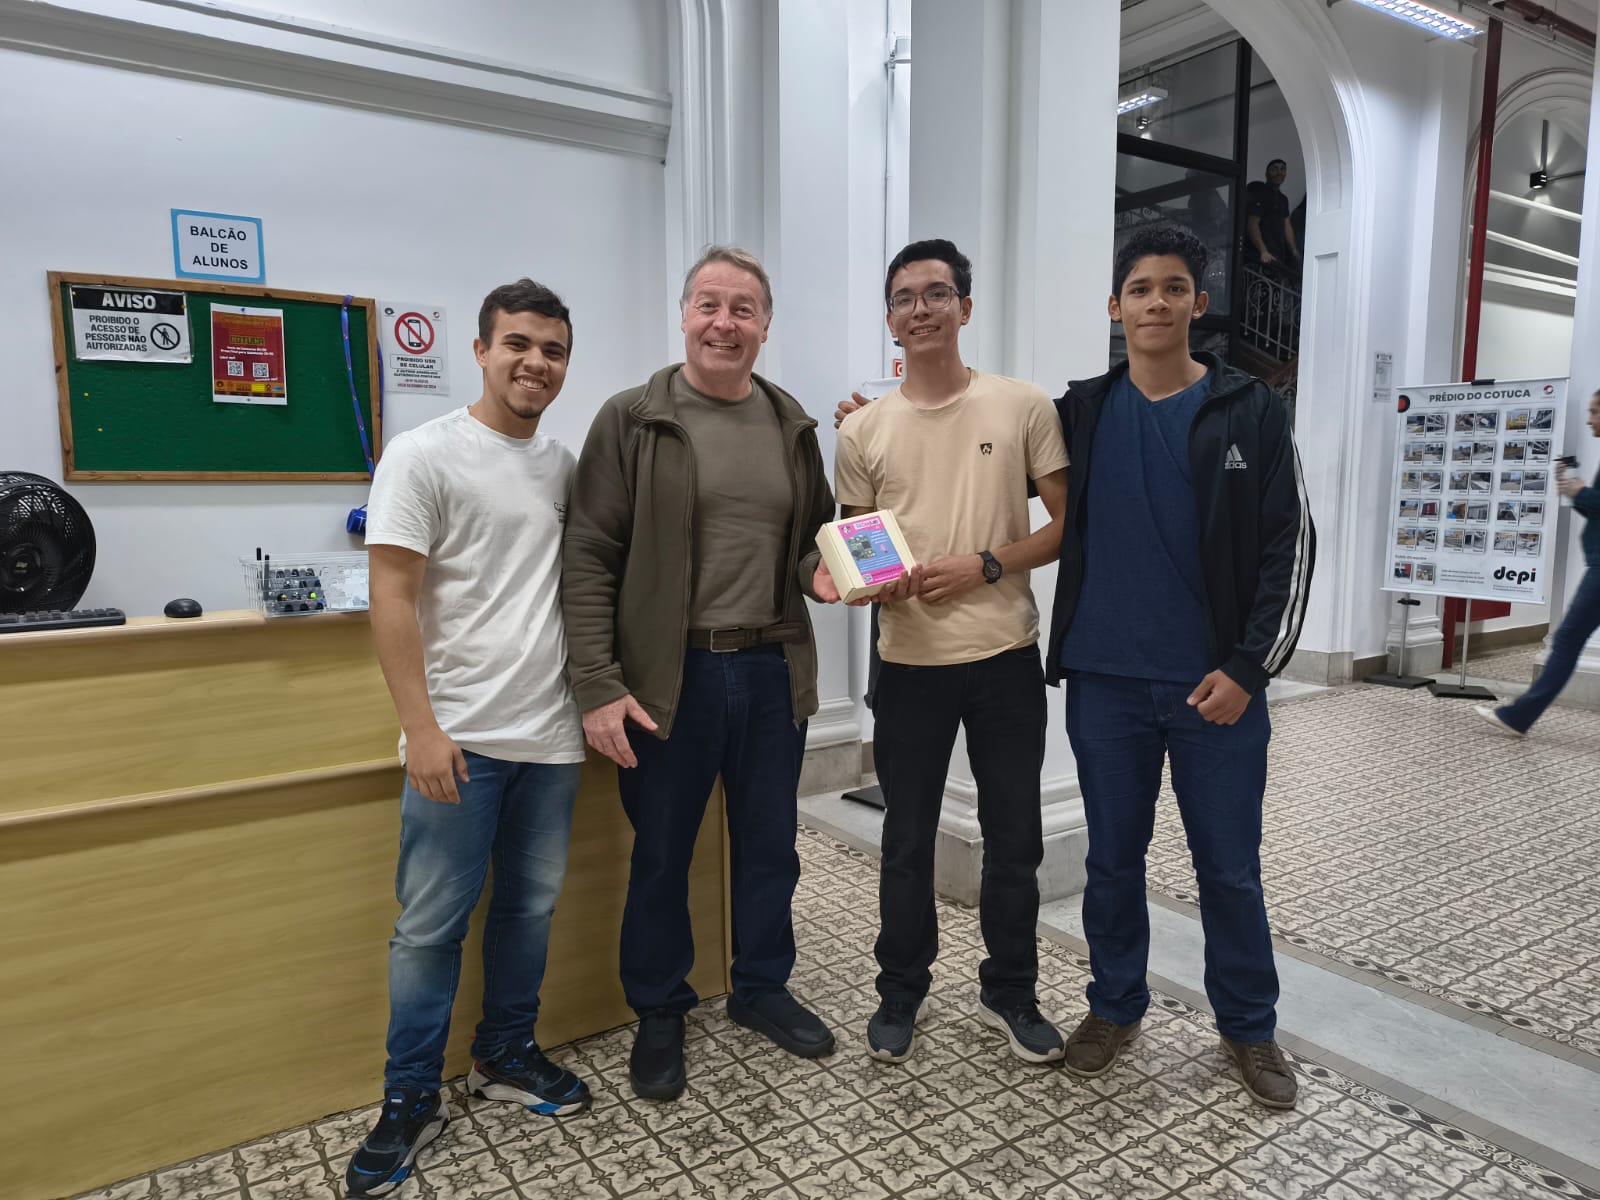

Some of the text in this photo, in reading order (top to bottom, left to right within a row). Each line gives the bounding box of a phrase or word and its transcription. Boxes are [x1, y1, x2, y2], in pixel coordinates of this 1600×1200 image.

[190, 225, 247, 241] BALCÃO
[210, 242, 229, 253] DE
[192, 255, 248, 270] ALUNOS
[101, 292, 157, 310] AVISO
[89, 315, 140, 325] PROIBIDO O
[91, 324, 140, 334] ACESSO DE
[85, 333, 127, 342] PESSOAS
[86, 342, 148, 352] AUTORIZADAS
[1429, 389, 1531, 403] PRÉDIO DO COTUCA
[1493, 566, 1537, 585] depi
